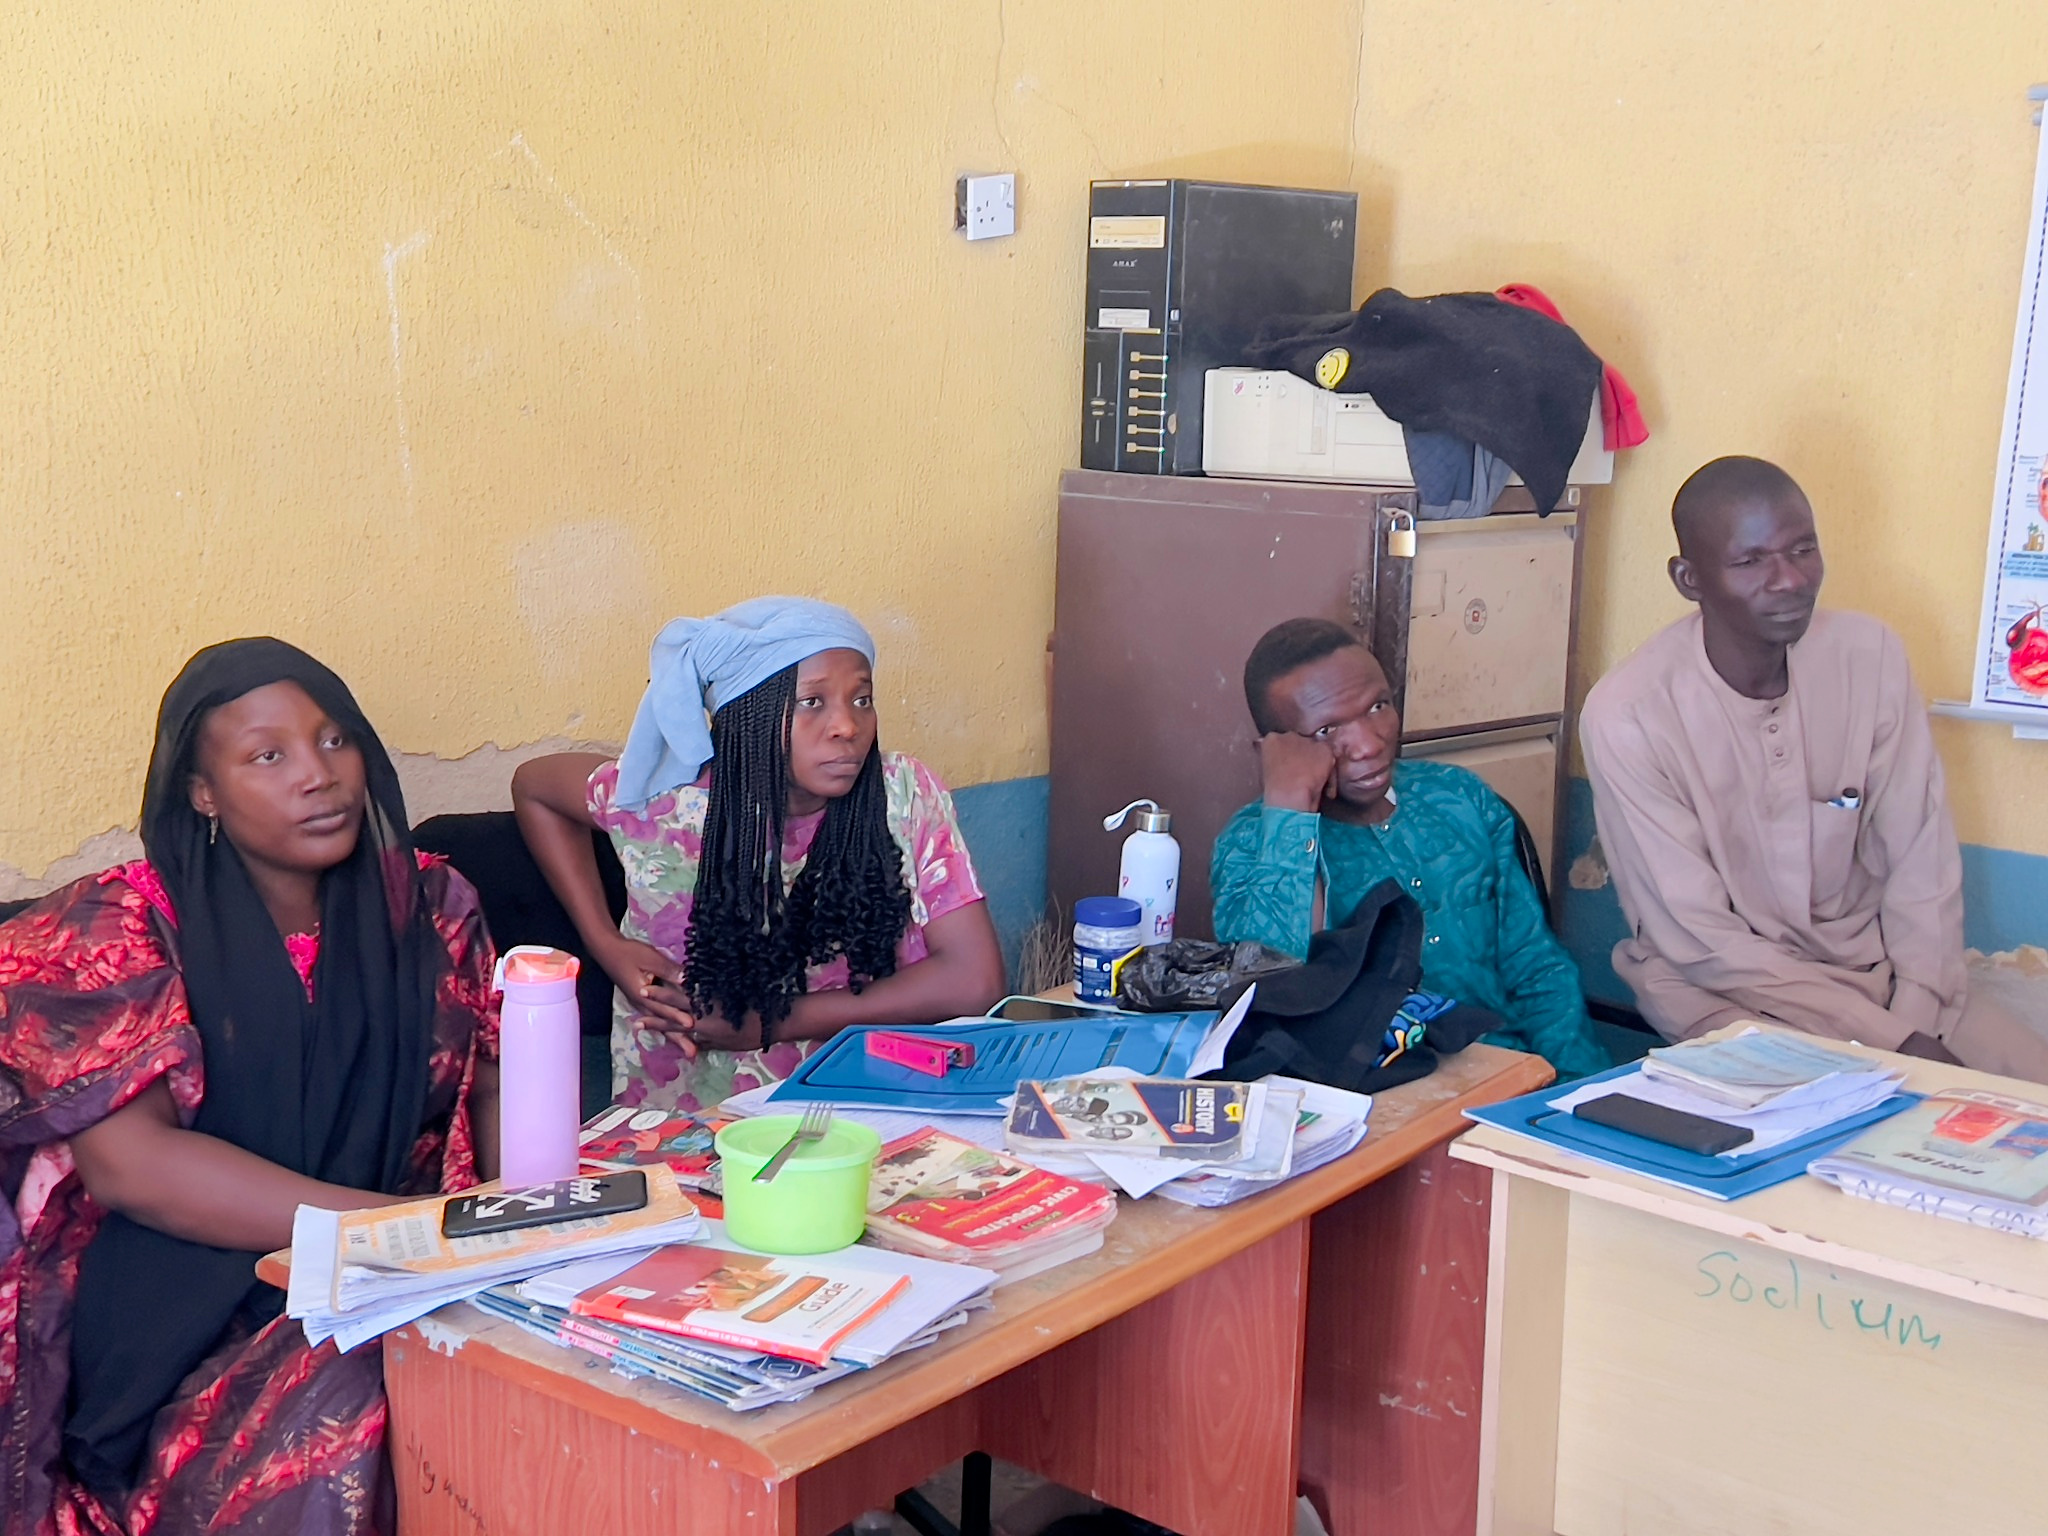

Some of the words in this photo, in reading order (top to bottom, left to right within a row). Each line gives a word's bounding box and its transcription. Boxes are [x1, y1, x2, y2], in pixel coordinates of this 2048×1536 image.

[1195, 1087, 1216, 1136] HISTORY
[1893, 1151, 1985, 1175] PRIDE
[1039, 1185, 1080, 1208] CIVIC
[962, 1204, 1045, 1239] EDUCATION
[798, 1280, 851, 1313] Guide
[1694, 1250, 1942, 1350] Sodium
